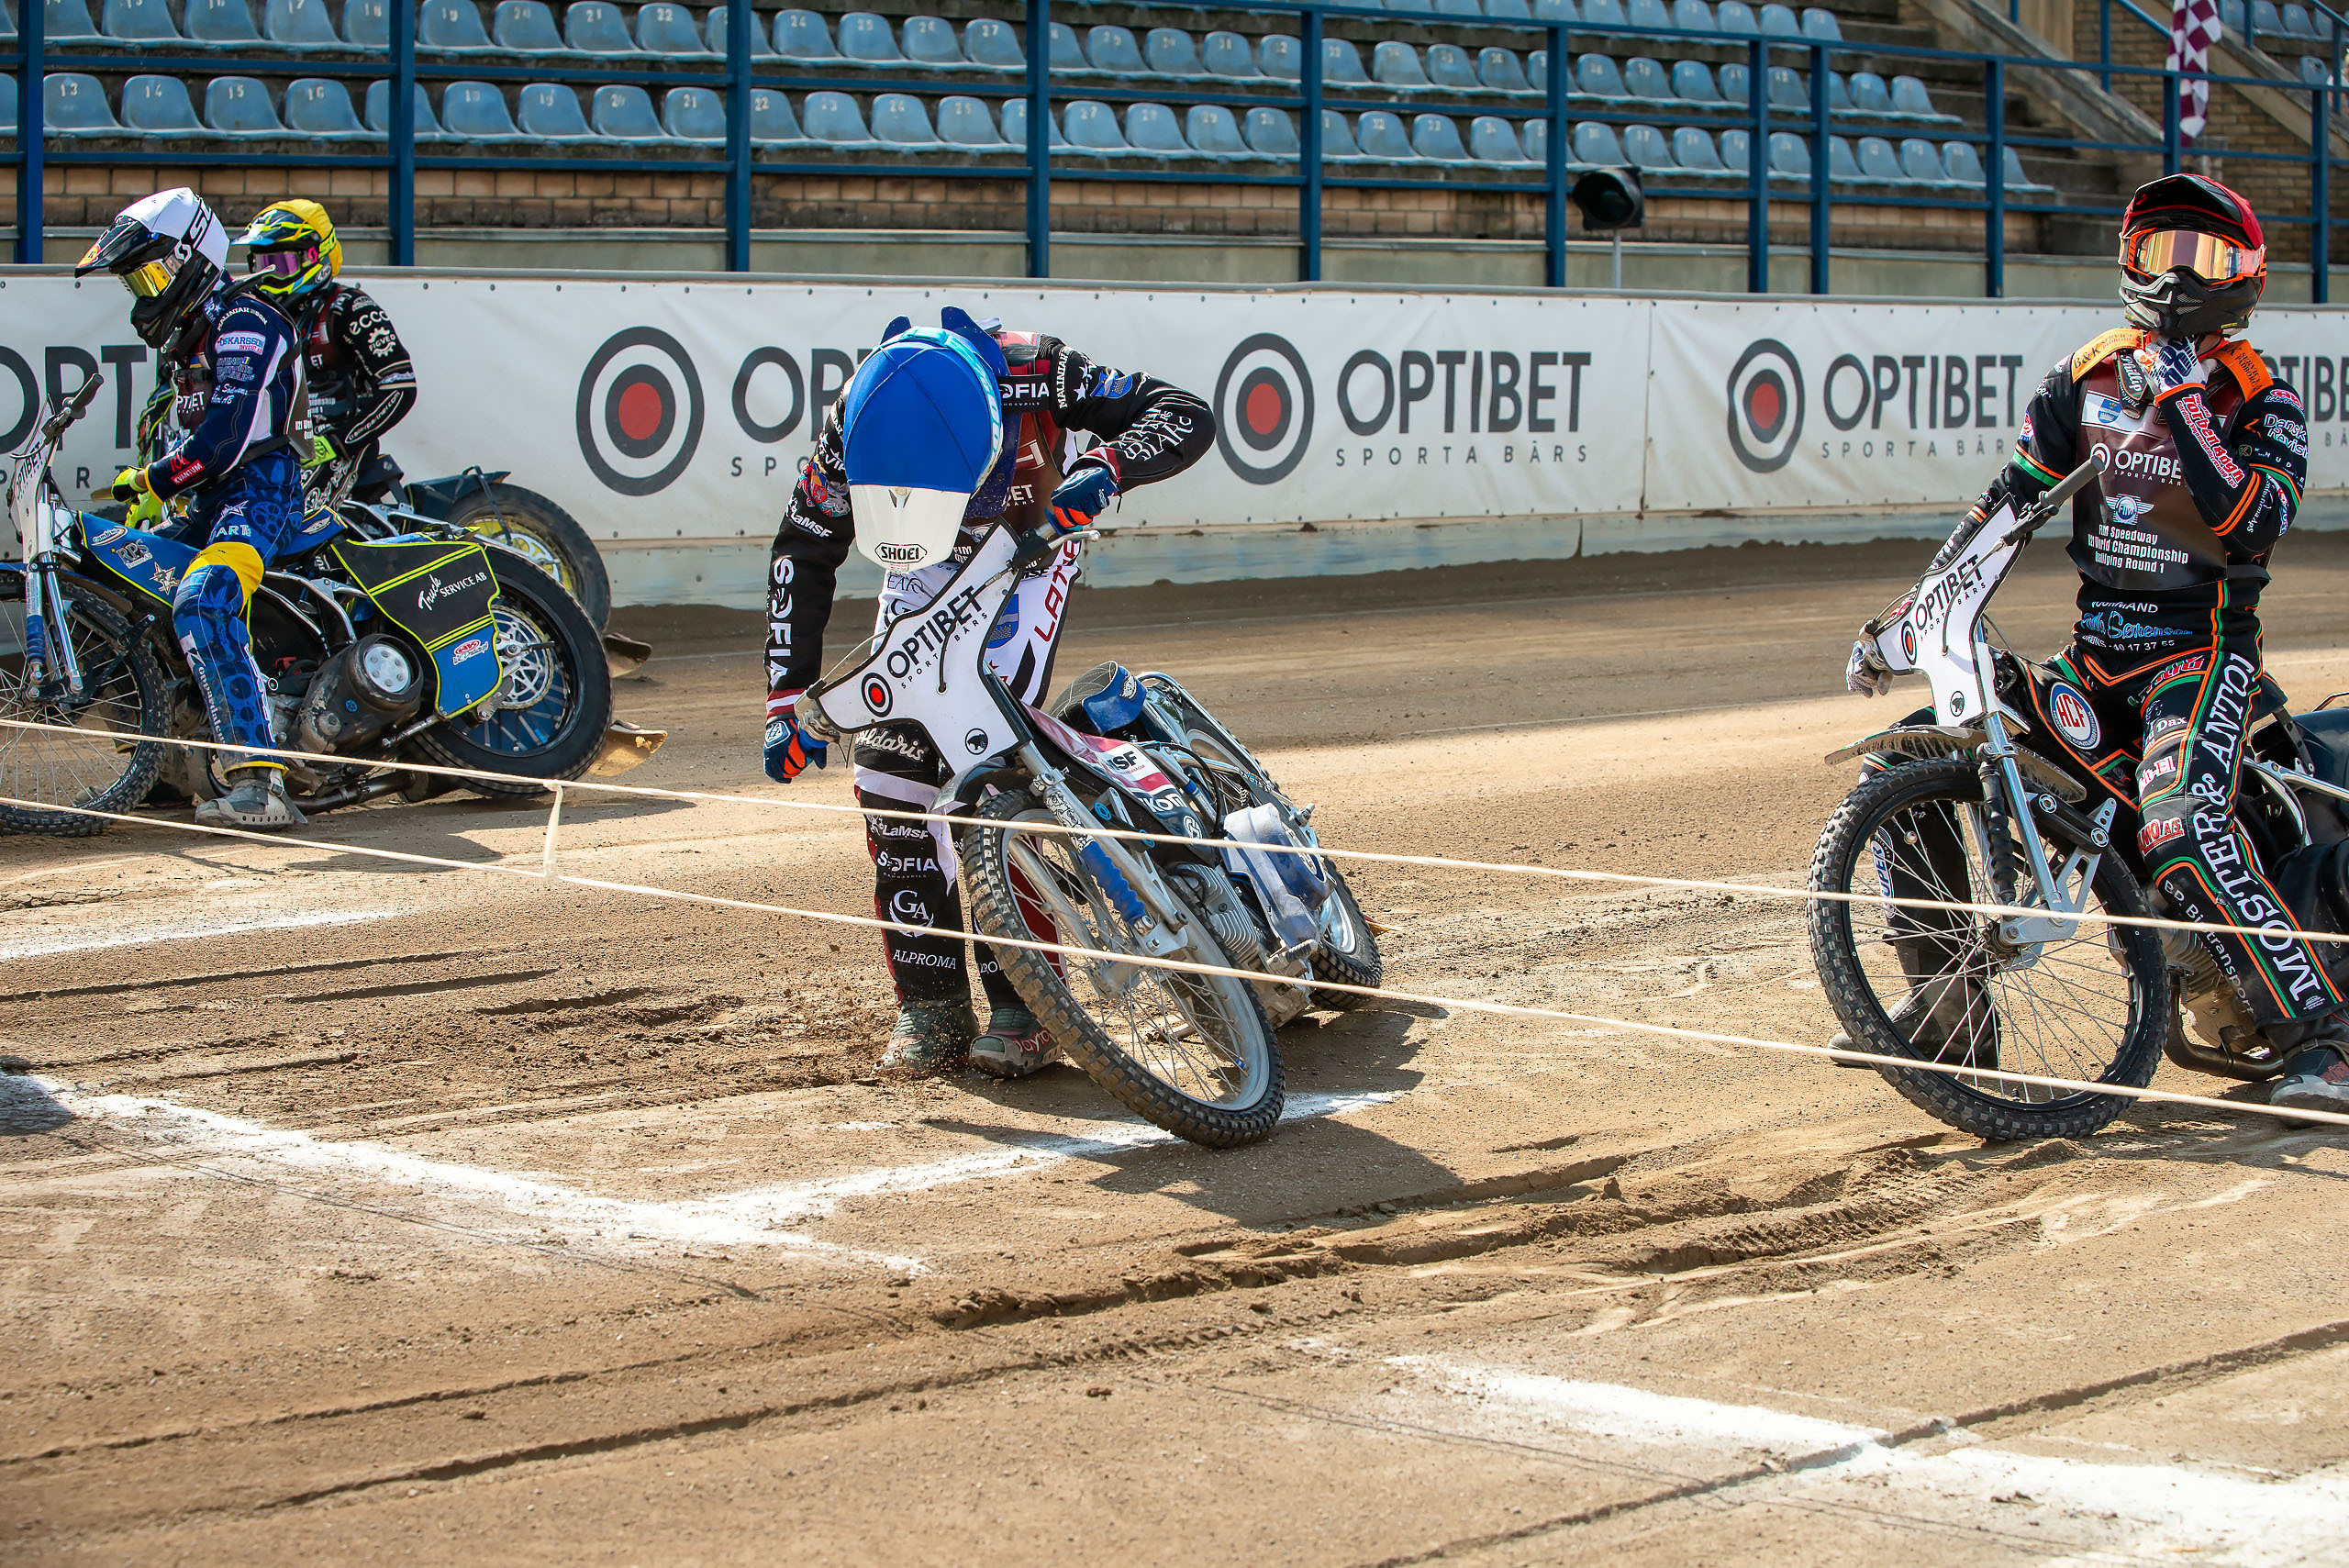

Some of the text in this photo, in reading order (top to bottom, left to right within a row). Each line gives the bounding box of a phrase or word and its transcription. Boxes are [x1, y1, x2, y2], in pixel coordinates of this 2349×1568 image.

[61, 83, 78, 96] 13
[145, 84, 162, 98] 14
[228, 84, 245, 99] 15
[308, 86, 325, 101] 16
[998, 382, 1050, 399] OFIA
[1337, 349, 1592, 437] OPTIBET
[1824, 353, 2024, 431] OPTIBET
[2264, 414, 2306, 443] Dansk
[1336, 440, 1587, 467] SPORTA BĀRS
[1821, 439, 2005, 459] SPORTA BĀR
[173, 462, 204, 484] KVANTUM
[2114, 450, 2182, 479] OPTIBE
[2114, 469, 2181, 486] SPORTA BĀR
[2099, 524, 2158, 545] FIM Speedway
[880, 546, 919, 561] SHOEI
[2095, 536, 2111, 551] World
[2112, 539, 2189, 564] Championship
[2125, 557, 2157, 573] Round
[2160, 562, 2165, 573] 1
[418, 572, 487, 611] Truck SERVICE AB
[1920, 583, 1987, 641] SPORT BĀRS
[887, 585, 982, 678] OPTIBET
[901, 612, 988, 689] SPORT BĀRS
[2128, 643, 2140, 651] 17
[2144, 641, 2157, 650] 37
[2056, 694, 2085, 728] HCF
[2156, 716, 2188, 732] Dax
[2191, 773, 2226, 806] &
[893, 949, 956, 970] ALPROMA
